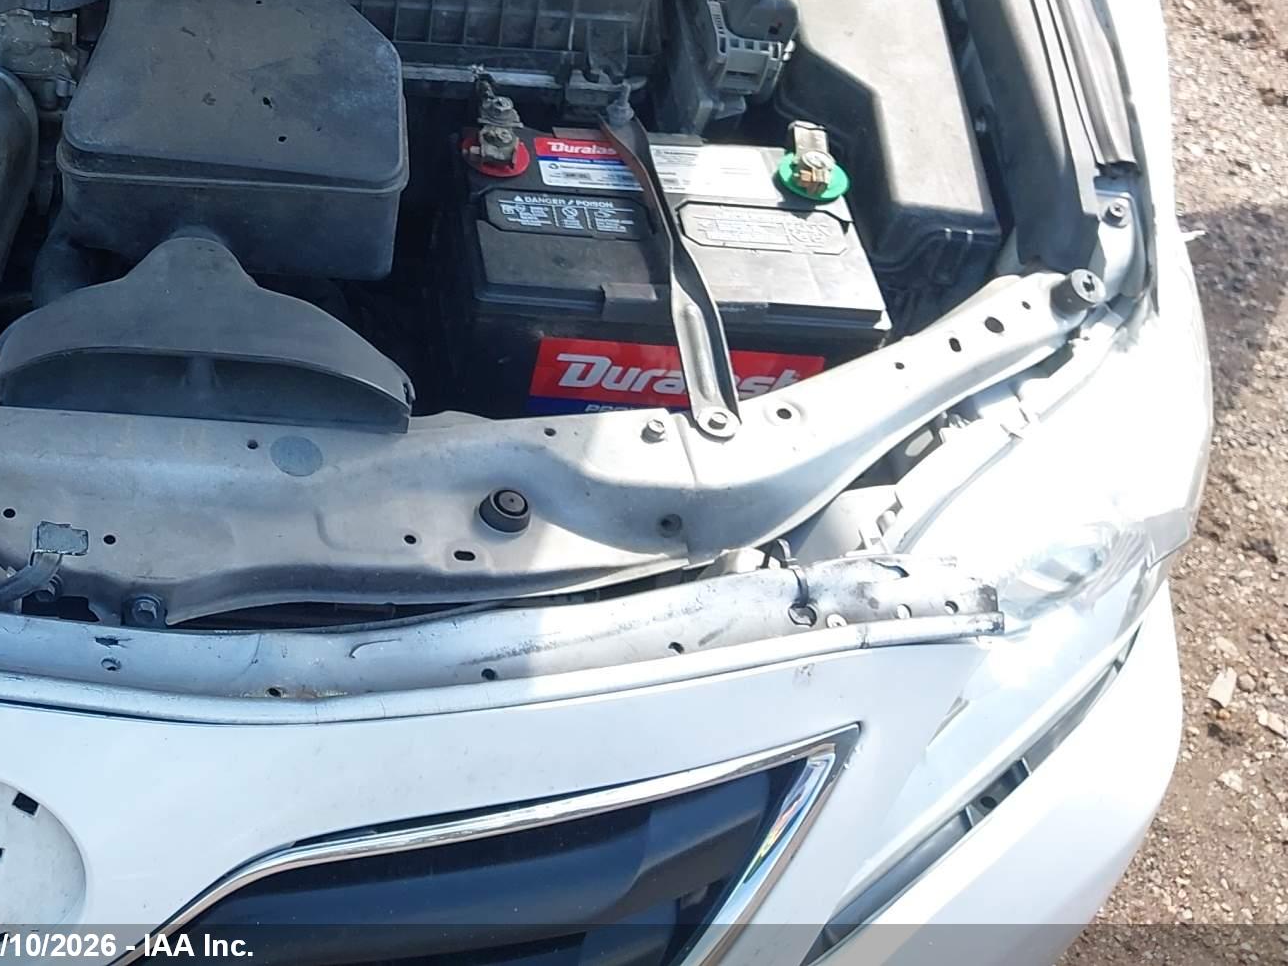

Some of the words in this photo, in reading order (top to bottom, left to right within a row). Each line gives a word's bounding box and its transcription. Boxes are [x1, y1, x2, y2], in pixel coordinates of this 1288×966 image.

[547, 141, 617, 155] Duralas
[524, 196, 566, 206] DANGER
[576, 200, 614, 208] POISON
[556, 352, 800, 401] Durast
